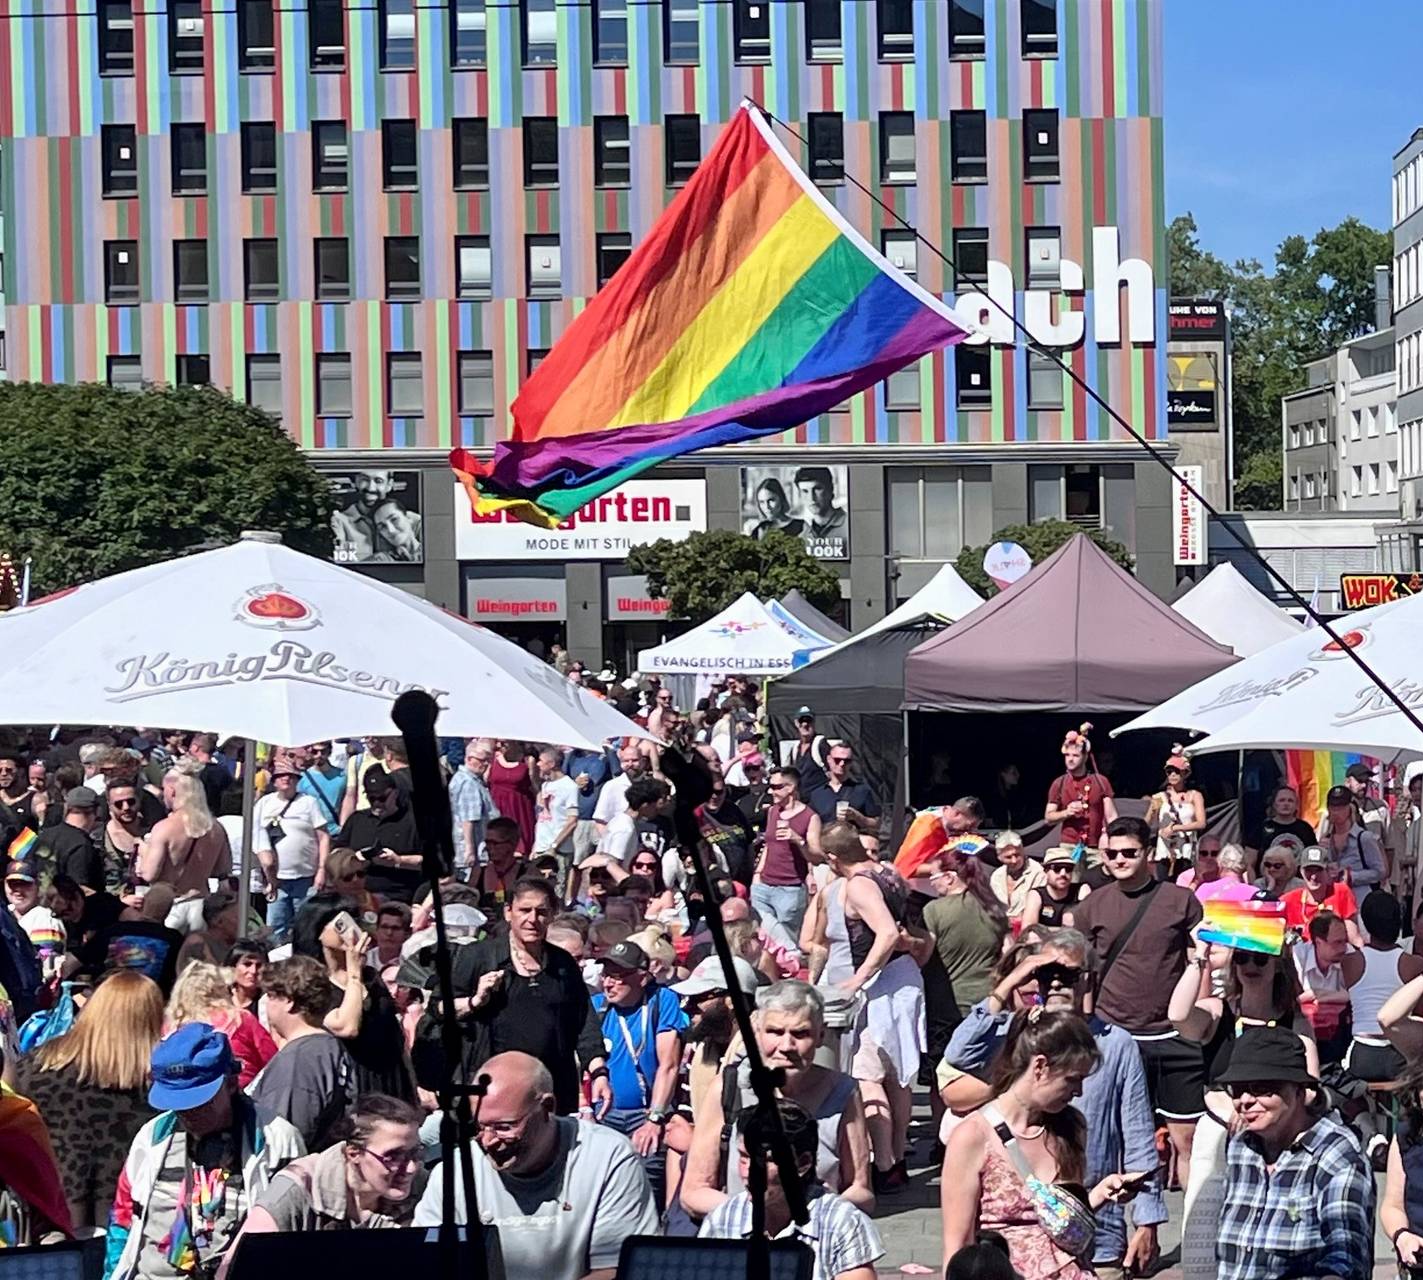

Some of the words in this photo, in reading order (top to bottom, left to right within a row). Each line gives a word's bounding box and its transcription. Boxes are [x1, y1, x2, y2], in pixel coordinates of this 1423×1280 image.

[526, 539, 569, 550] MODE
[574, 538, 599, 550] MIT
[1343, 576, 1398, 609] WOK
[476, 600, 557, 616] Weingarten
[653, 656, 745, 670] EVANGELISCH
[104, 652, 267, 692] König
